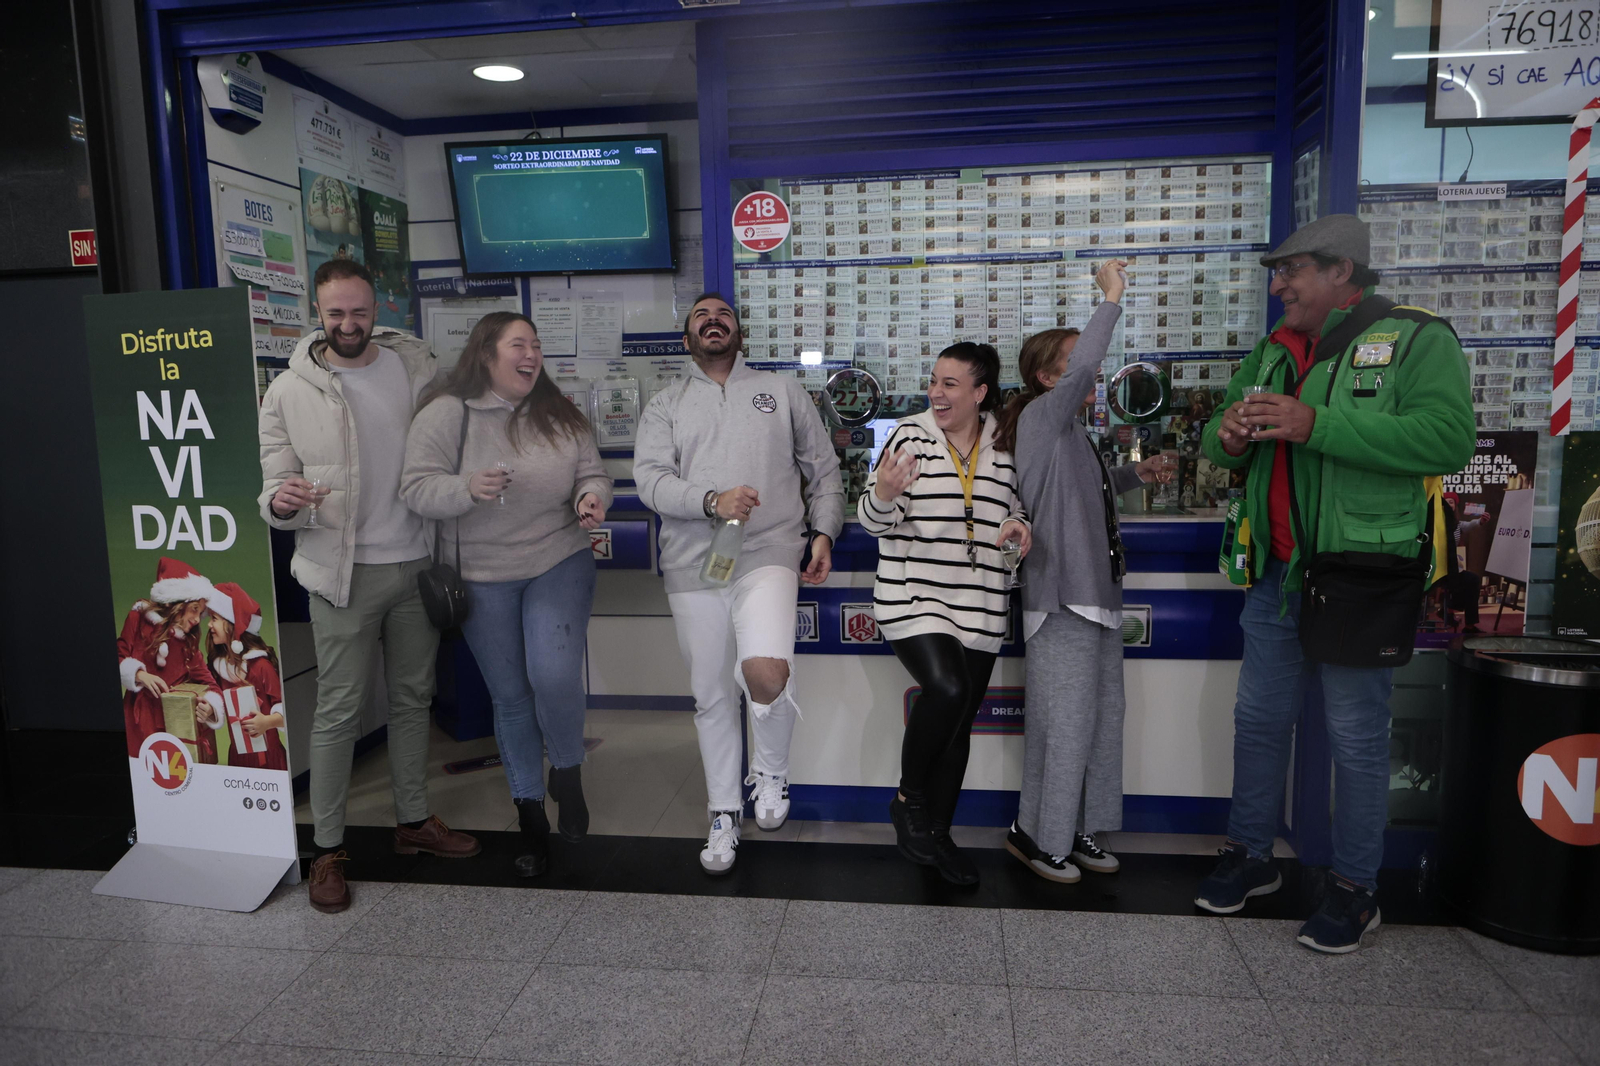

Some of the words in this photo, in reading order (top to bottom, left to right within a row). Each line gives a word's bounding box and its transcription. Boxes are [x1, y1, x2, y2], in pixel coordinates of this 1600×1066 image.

[1516, 67, 1548, 84] CAE
[510, 152, 524, 161] 22
[525, 151, 541, 161] DE
[542, 149, 602, 160] DICIEMBRE
[521, 161, 580, 169] EXTRAORDINARIO
[1438, 187, 1474, 197] LOTERIA
[1475, 185, 1506, 196] JUEVES
[244, 199, 273, 223] BOTES
[744, 198, 776, 218] +18
[373, 211, 398, 227] OJALÁ
[73, 239, 92, 257] SIN
[468, 277, 513, 288] Nacional
[121, 328, 213, 355] Disfruta
[1369, 333, 1398, 341] ONCE
[650, 345, 665, 353] LOS
[160, 358, 180, 381] la
[136, 389, 216, 440] NA
[1494, 454, 1512, 464] AL
[149, 446, 204, 499] VI
[1443, 475, 1461, 484] NO
[1463, 475, 1481, 484] DE
[1483, 475, 1509, 484] SER
[132, 505, 237, 551] DAD
[1498, 527, 1516, 537] EURO
[164, 789, 182, 797] CENTRO
[181, 767, 194, 792] COMERCIAL
[223, 777, 279, 792] ccn4.com
